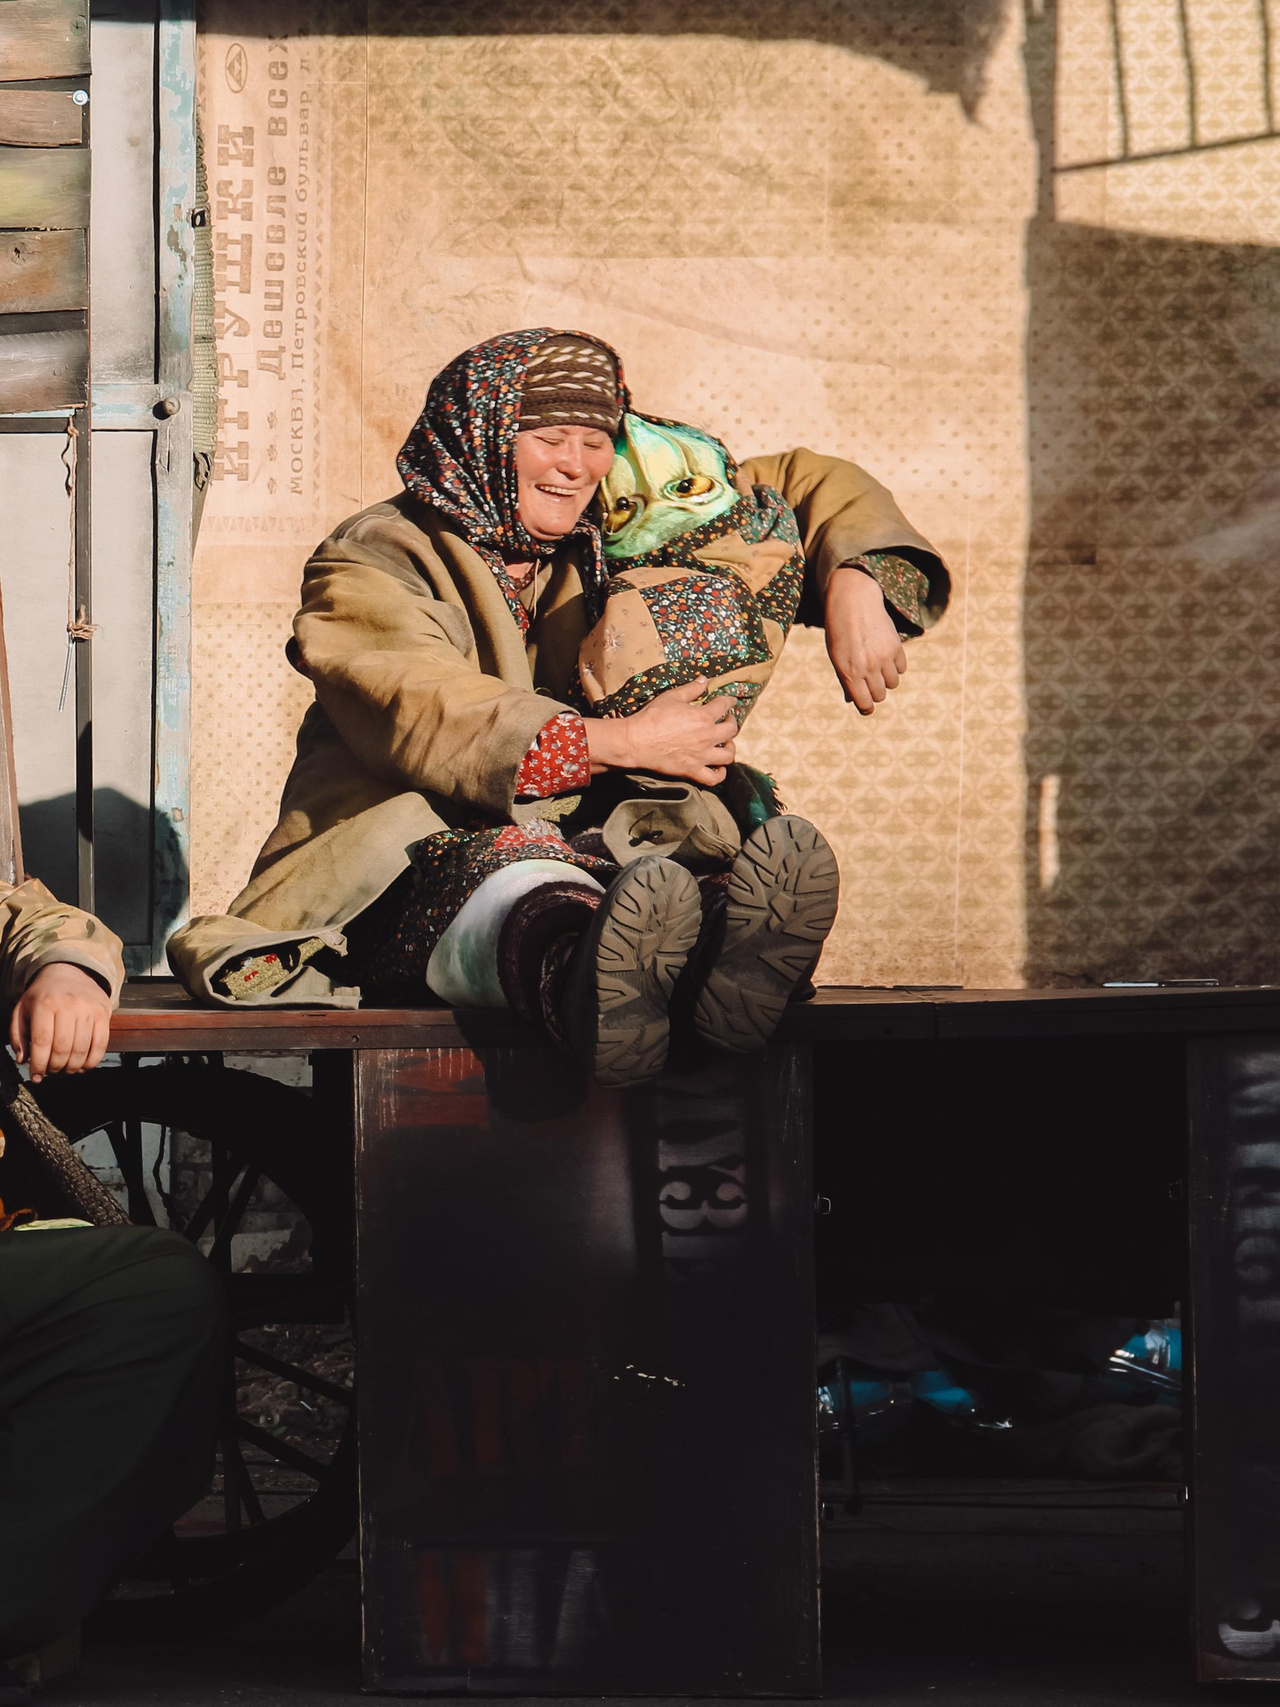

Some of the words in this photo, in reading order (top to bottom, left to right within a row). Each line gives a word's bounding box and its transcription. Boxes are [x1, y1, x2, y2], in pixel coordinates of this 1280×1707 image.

[266, 34, 289, 137] всех
[295, 84, 312, 203] бульвар,
[213, 124, 255, 482] ИГРУШКИ
[256, 166, 287, 381] Дешевле
[291, 211, 308, 370] Петровский
